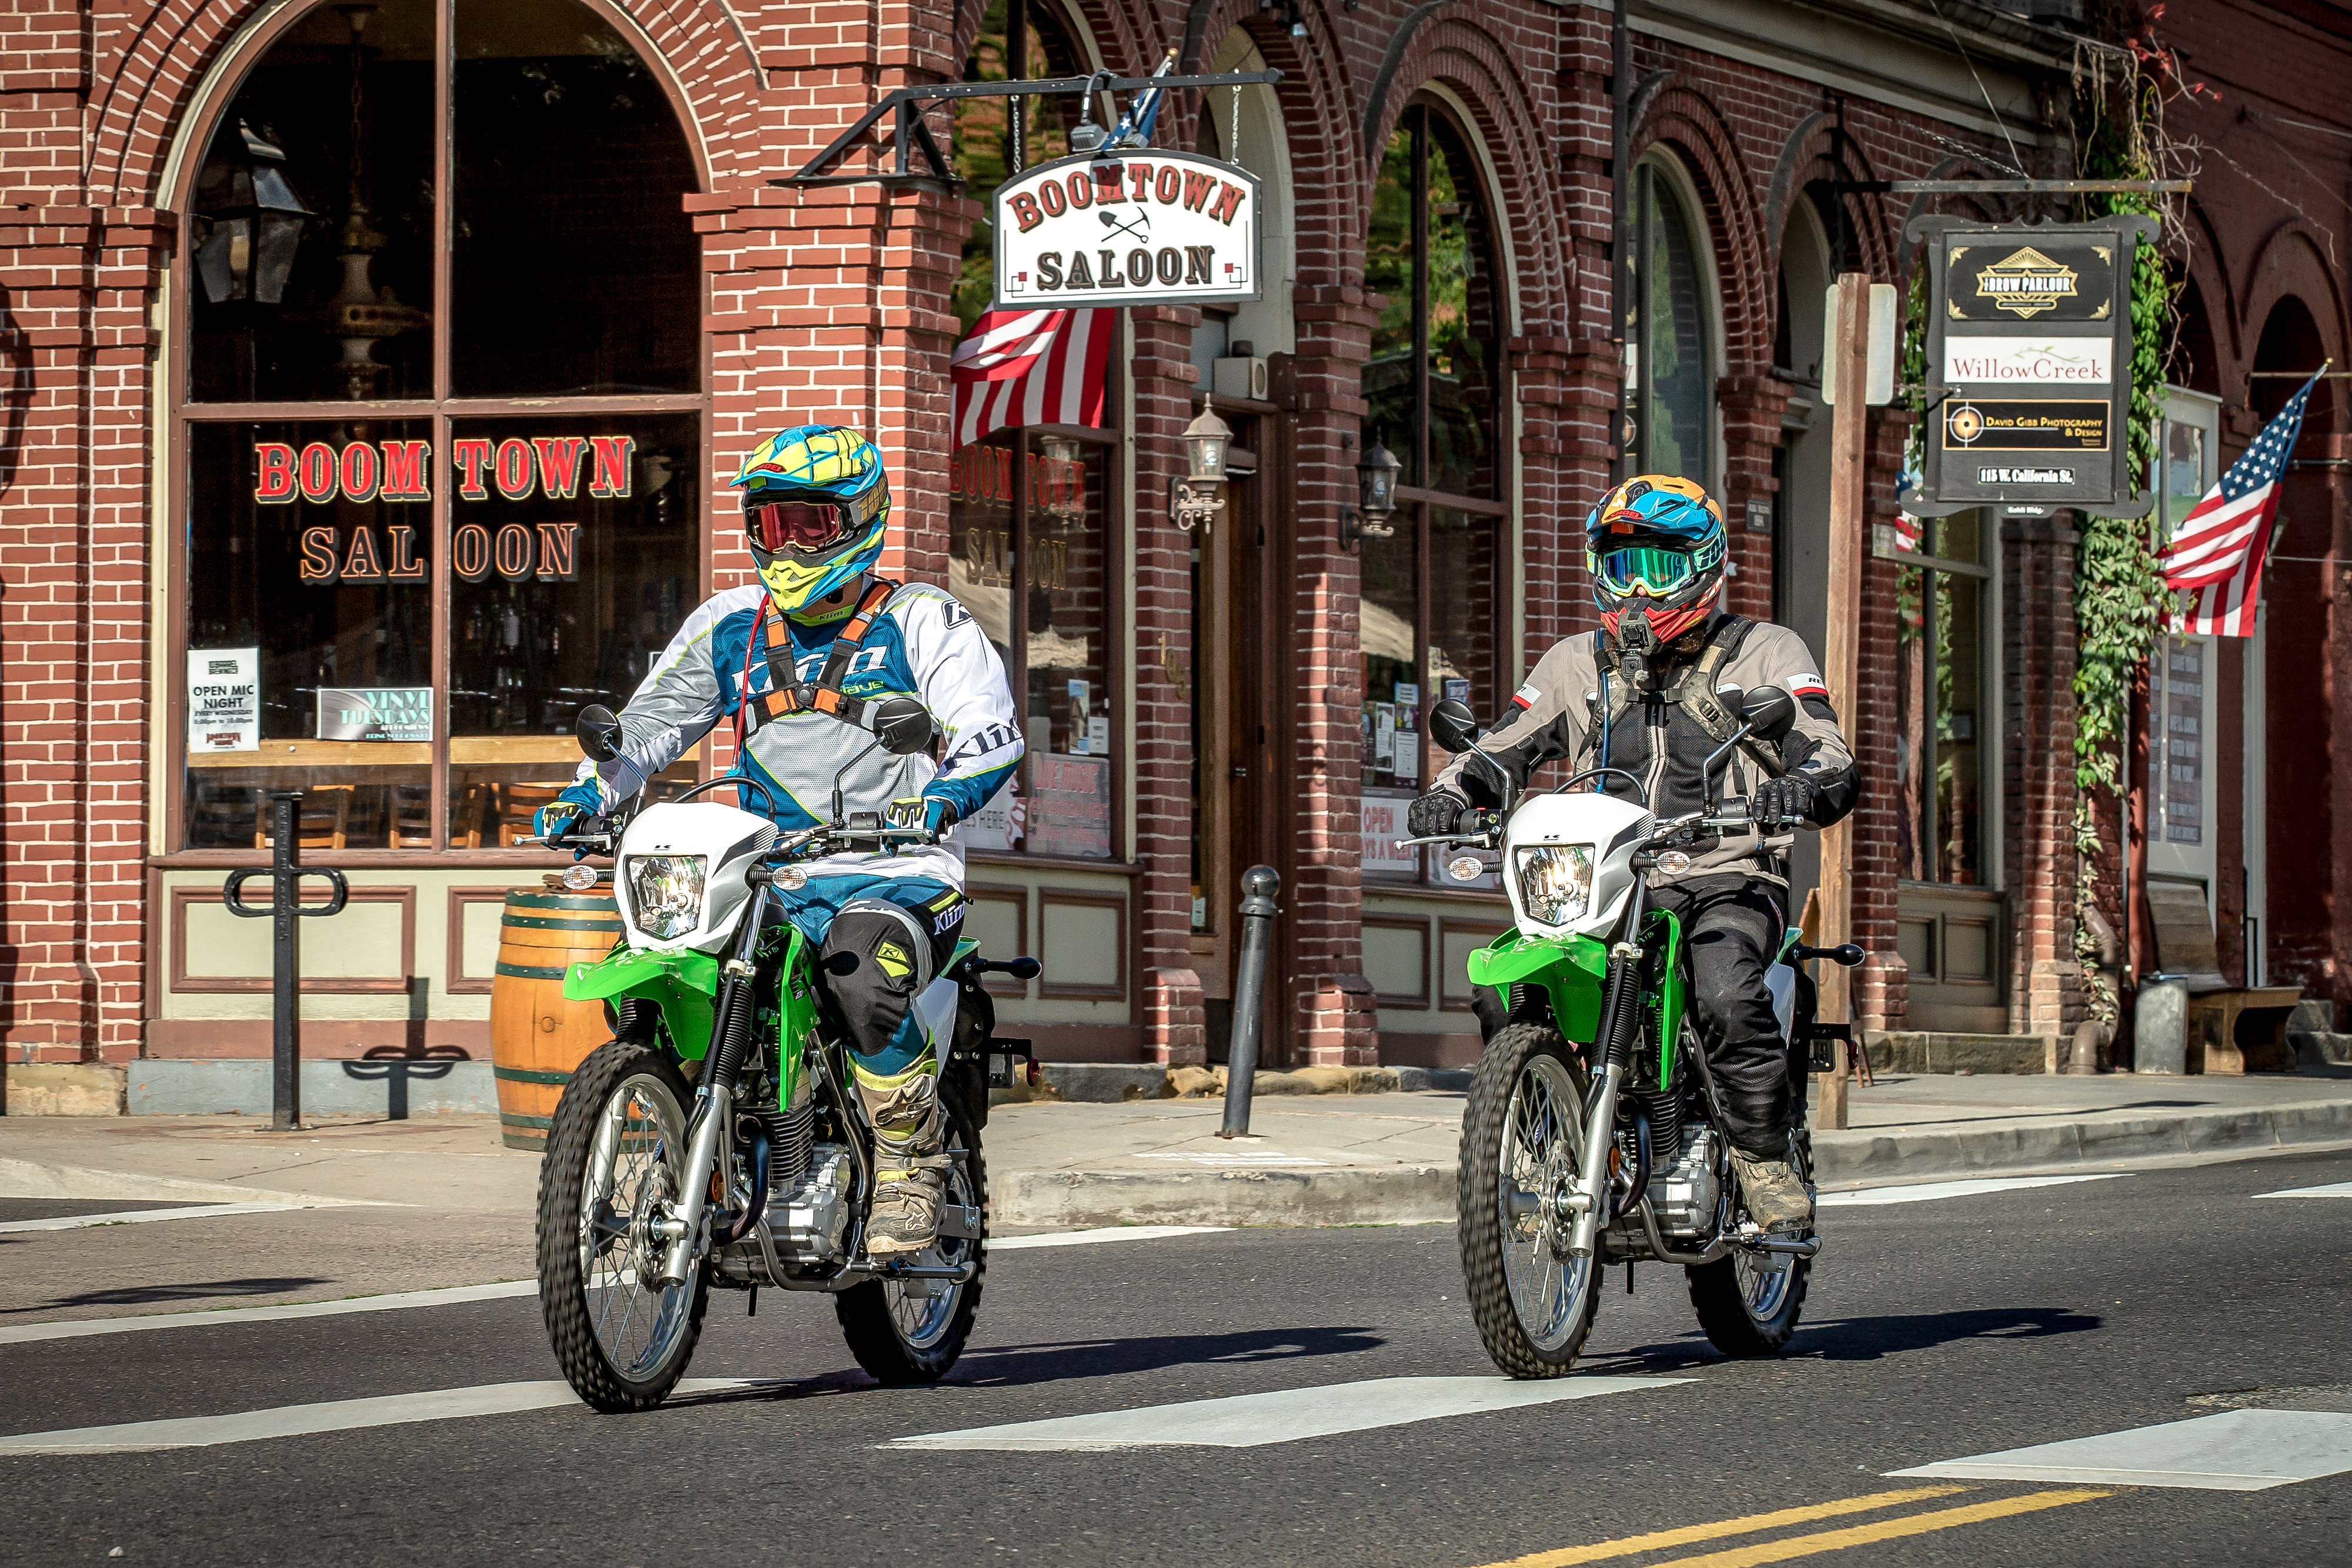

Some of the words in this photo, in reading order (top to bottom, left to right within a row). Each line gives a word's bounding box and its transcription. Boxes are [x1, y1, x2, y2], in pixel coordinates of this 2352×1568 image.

[1005, 163, 1245, 233] BOOMTOWN
[1037, 245, 1215, 291] SALOON
[2022, 277, 2070, 292] PARLOUR
[1953, 358, 2103, 379] WillowCreek
[1986, 416, 2014, 427] DAVID
[2016, 416, 2038, 427] GIBB
[2040, 416, 2103, 427] PHOTOGRAPHY
[2065, 427, 2073, 437] &
[2074, 427, 2103, 437] DESIGN
[255, 440, 431, 504] BOOM
[453, 436, 635, 501] TOWN
[1980, 469, 1998, 483] 115
[1999, 469, 2012, 483] W.
[2012, 469, 2059, 483] California
[2060, 469, 2073, 483] St.
[732, 646, 887, 695] Kim
[193, 686, 227, 696] OPEN
[231, 684, 254, 696] MIC
[204, 697, 243, 708] NIGHT
[366, 691, 429, 709] VINYL
[339, 709, 430, 724] TUESDAYS
[1363, 806, 1394, 833] OPEN
